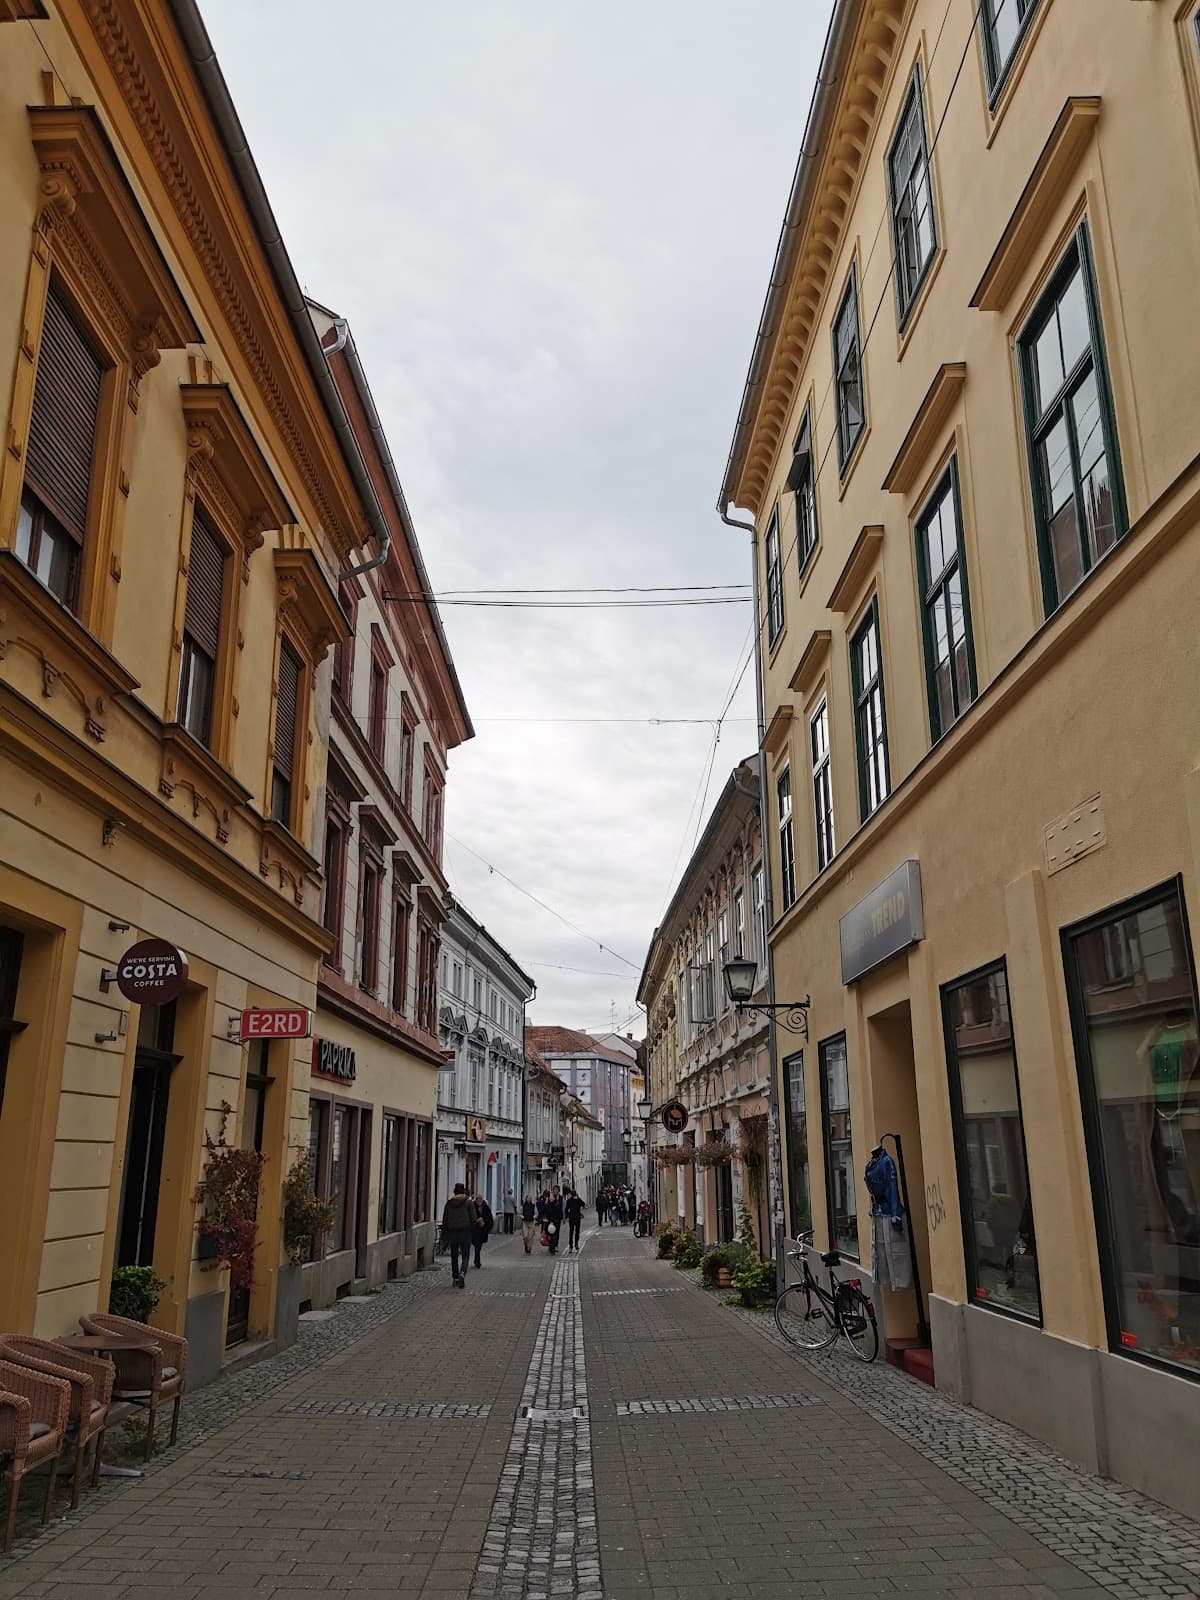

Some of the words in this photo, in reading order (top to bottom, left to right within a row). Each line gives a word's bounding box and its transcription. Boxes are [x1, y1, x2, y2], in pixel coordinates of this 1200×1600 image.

[148, 955, 176, 963] SERVING
[122, 963, 177, 979] COSTA
[134, 979, 165, 987] COFFEE
[248, 1013, 302, 1033] E2RD
[319, 1039, 356, 1080] PAPRIKA
